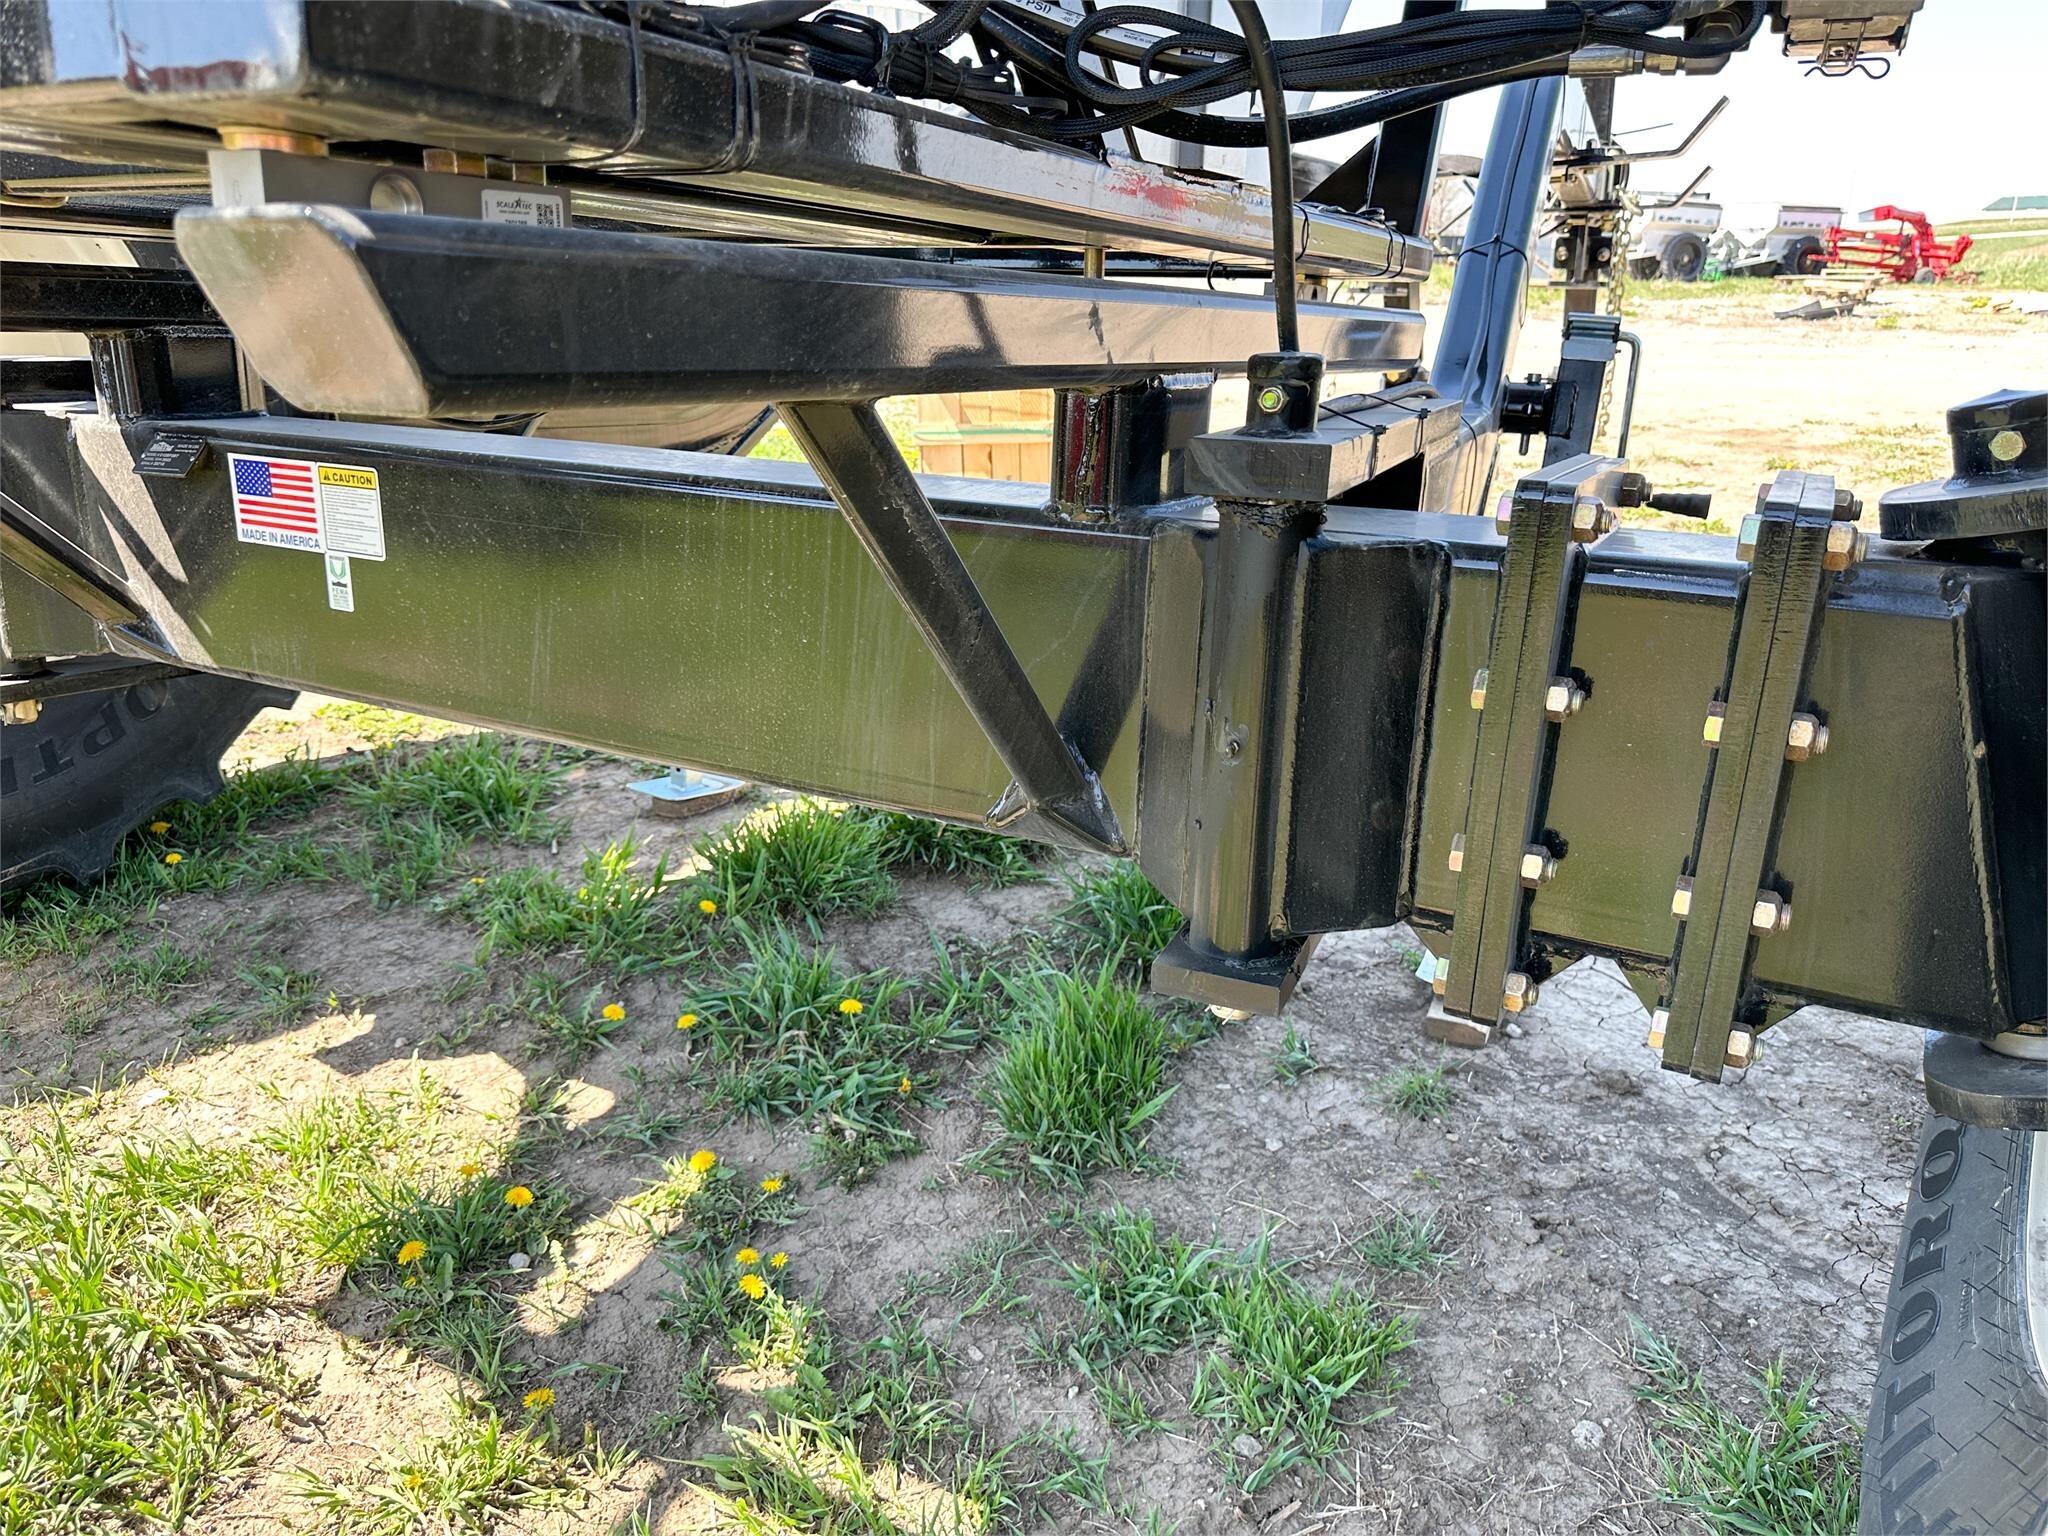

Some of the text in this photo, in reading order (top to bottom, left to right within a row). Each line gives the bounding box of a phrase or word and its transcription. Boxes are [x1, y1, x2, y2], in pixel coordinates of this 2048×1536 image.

[1026, 0, 1052, 14] PSI)
[332, 472, 373, 486] CAUTION
[242, 527, 321, 550] MADE IN AMERICA
